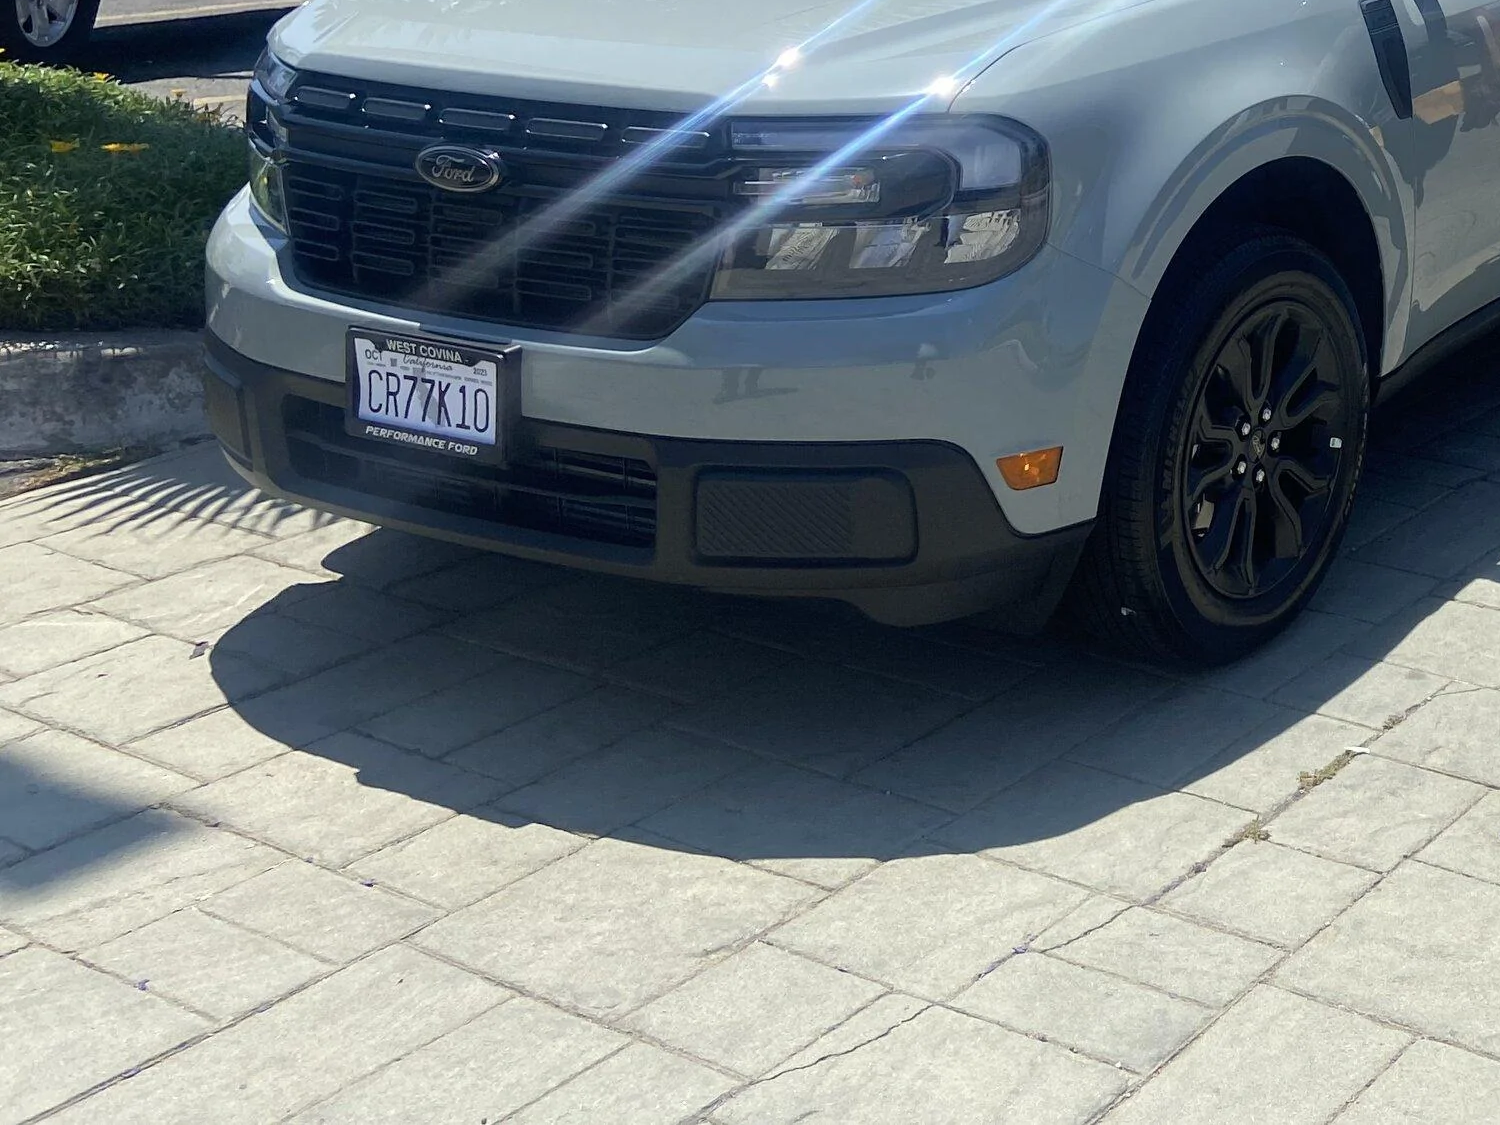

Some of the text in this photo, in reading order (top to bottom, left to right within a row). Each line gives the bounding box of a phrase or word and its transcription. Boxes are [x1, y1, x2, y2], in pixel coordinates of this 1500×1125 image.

[431, 154, 476, 183] Ford
[364, 348, 383, 362] OCT
[386, 338, 463, 364] WEST COVINA
[402, 354, 453, 373] California
[368, 369, 490, 433] CR77K10
[365, 426, 478, 456] PERFORMANCE FORD
